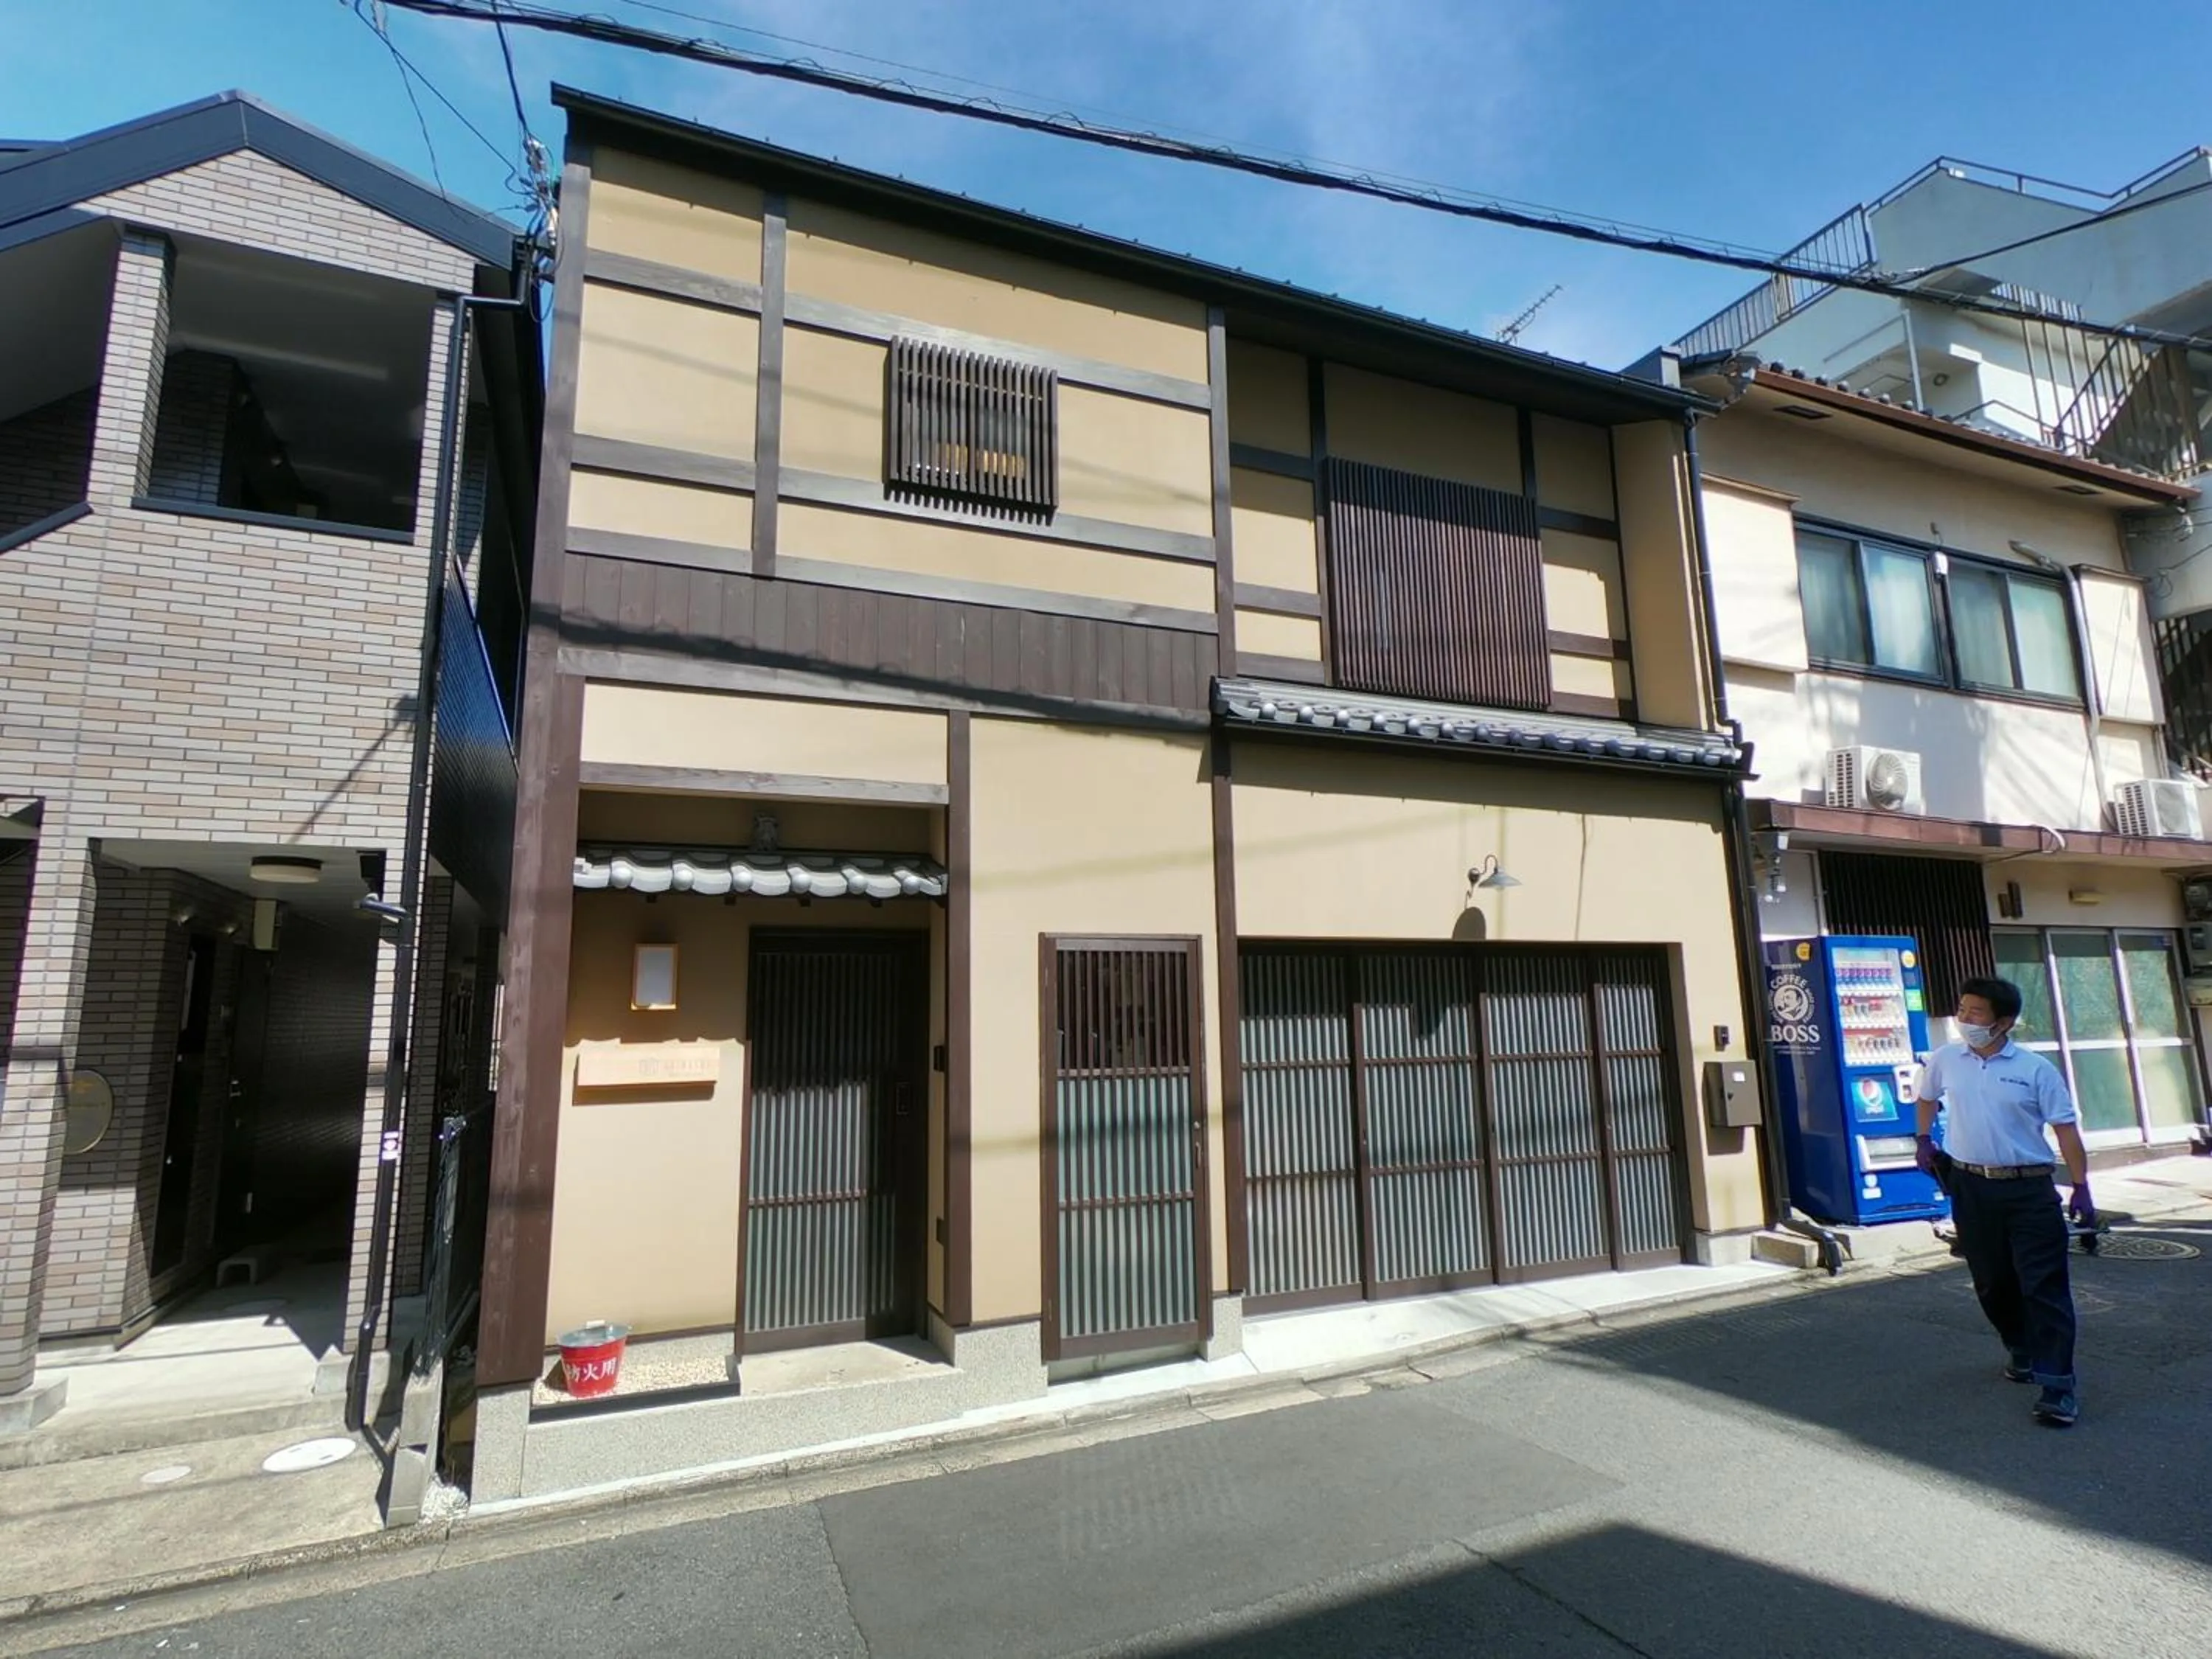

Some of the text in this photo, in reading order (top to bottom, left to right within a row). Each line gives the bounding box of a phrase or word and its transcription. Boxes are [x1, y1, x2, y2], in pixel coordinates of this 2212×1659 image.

[1770, 974, 1808, 988] COFFEE
[1770, 1024, 1820, 1043] BOSS
[566, 1357, 617, 1382] 防火用
